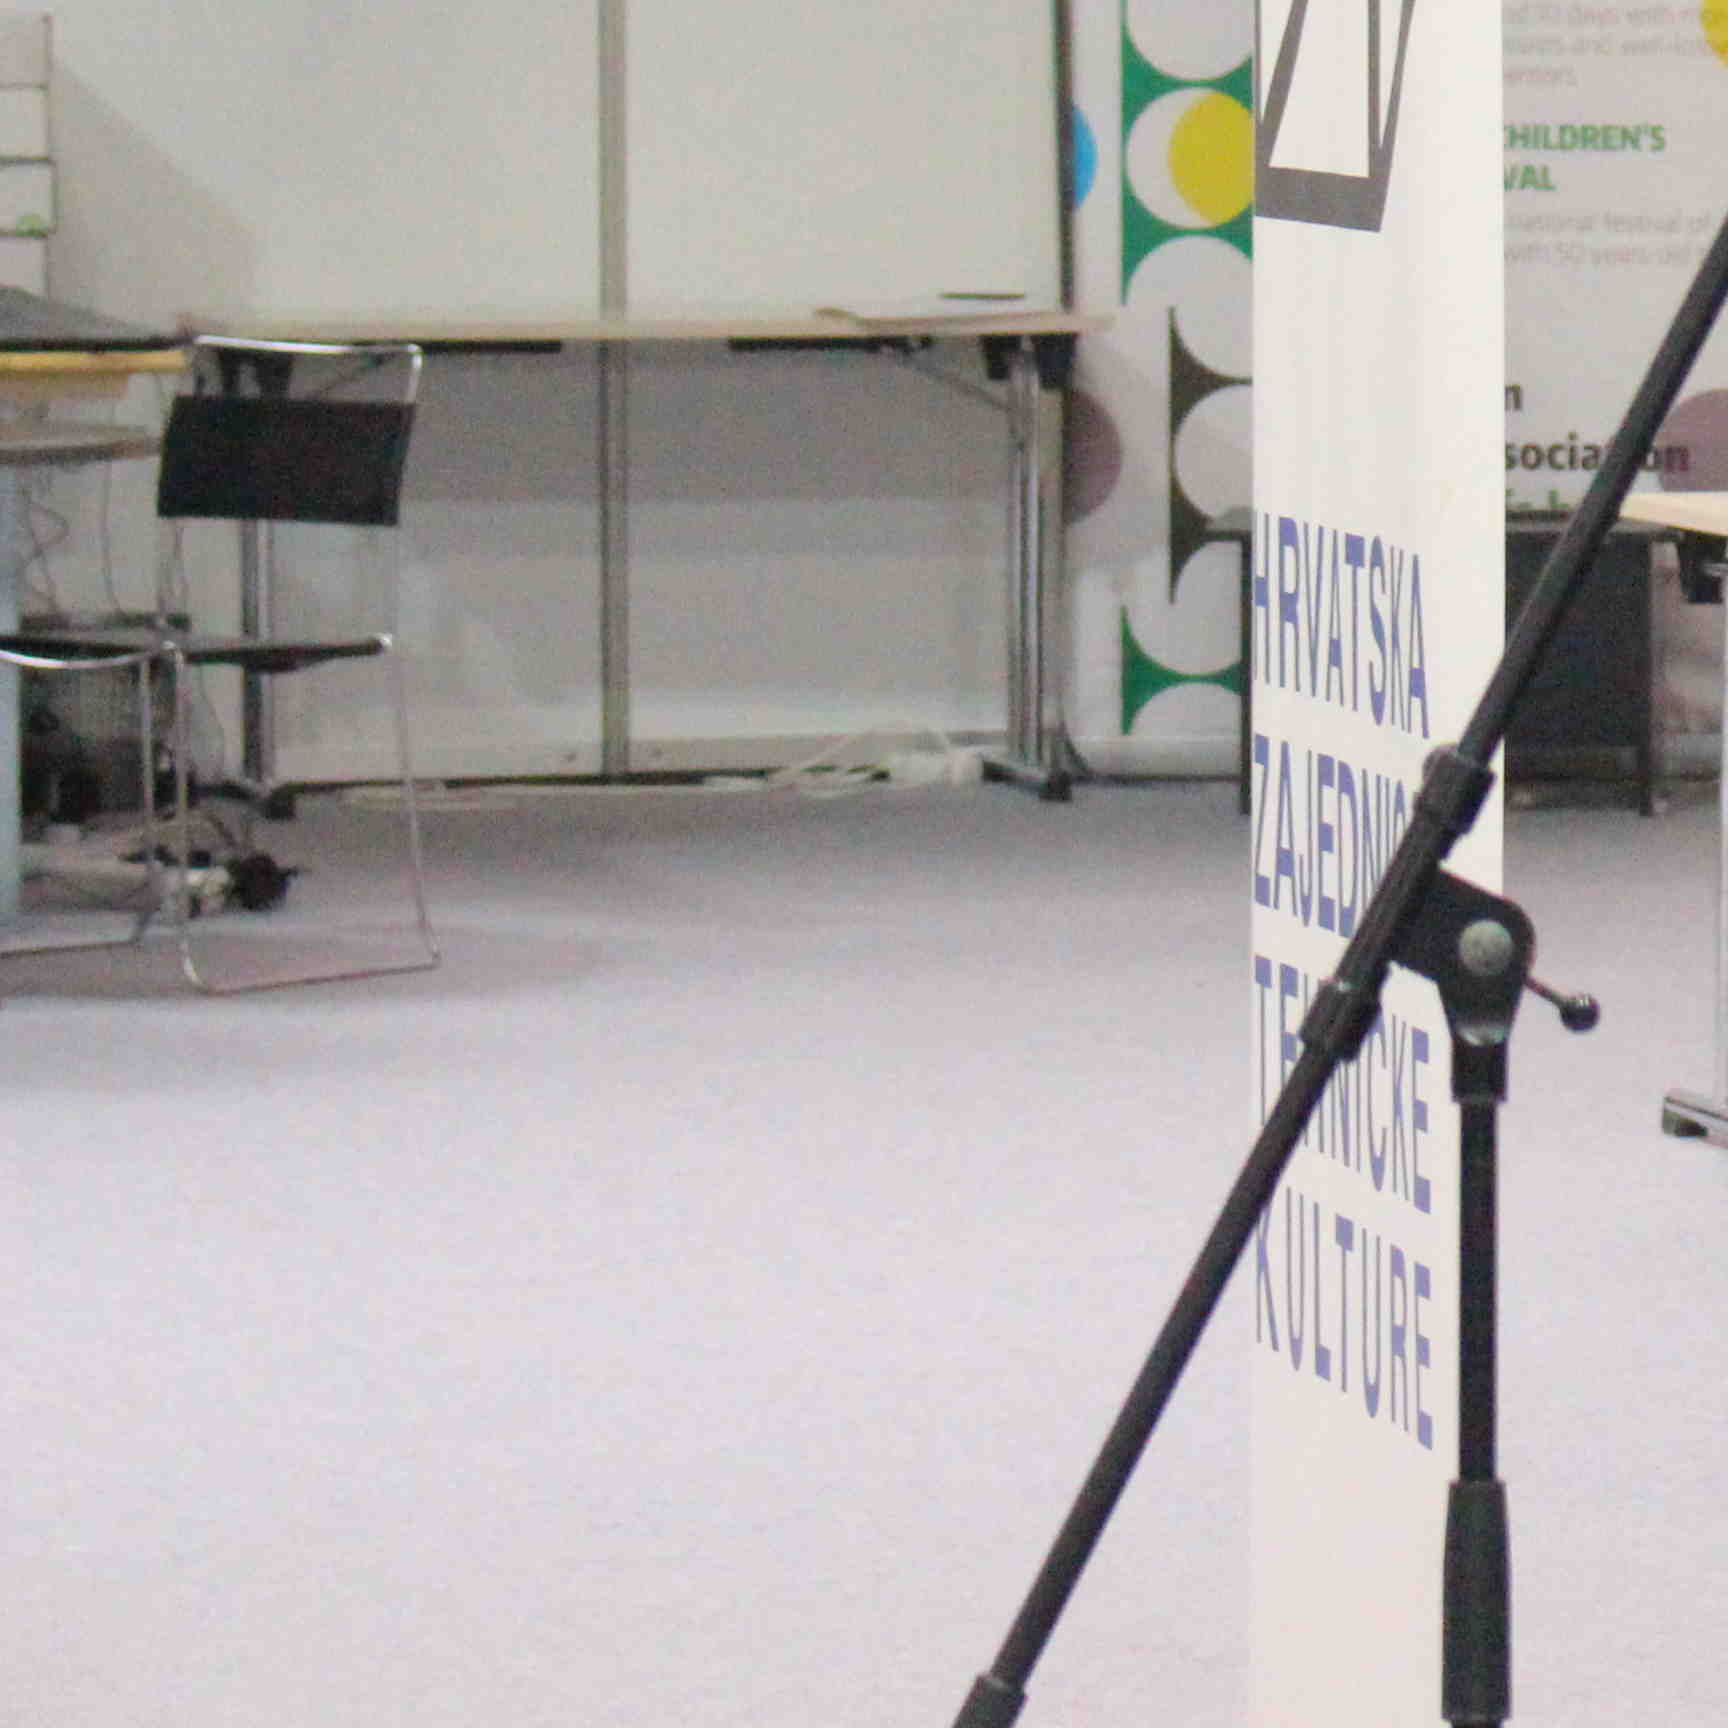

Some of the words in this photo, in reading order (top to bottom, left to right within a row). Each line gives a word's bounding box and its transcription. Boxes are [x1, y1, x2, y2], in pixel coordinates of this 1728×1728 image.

[1504, 432, 1690, 472] sociaon
[1254, 511, 1430, 739] HRVATSKA
[1254, 1184, 1433, 1451] KULTURE
